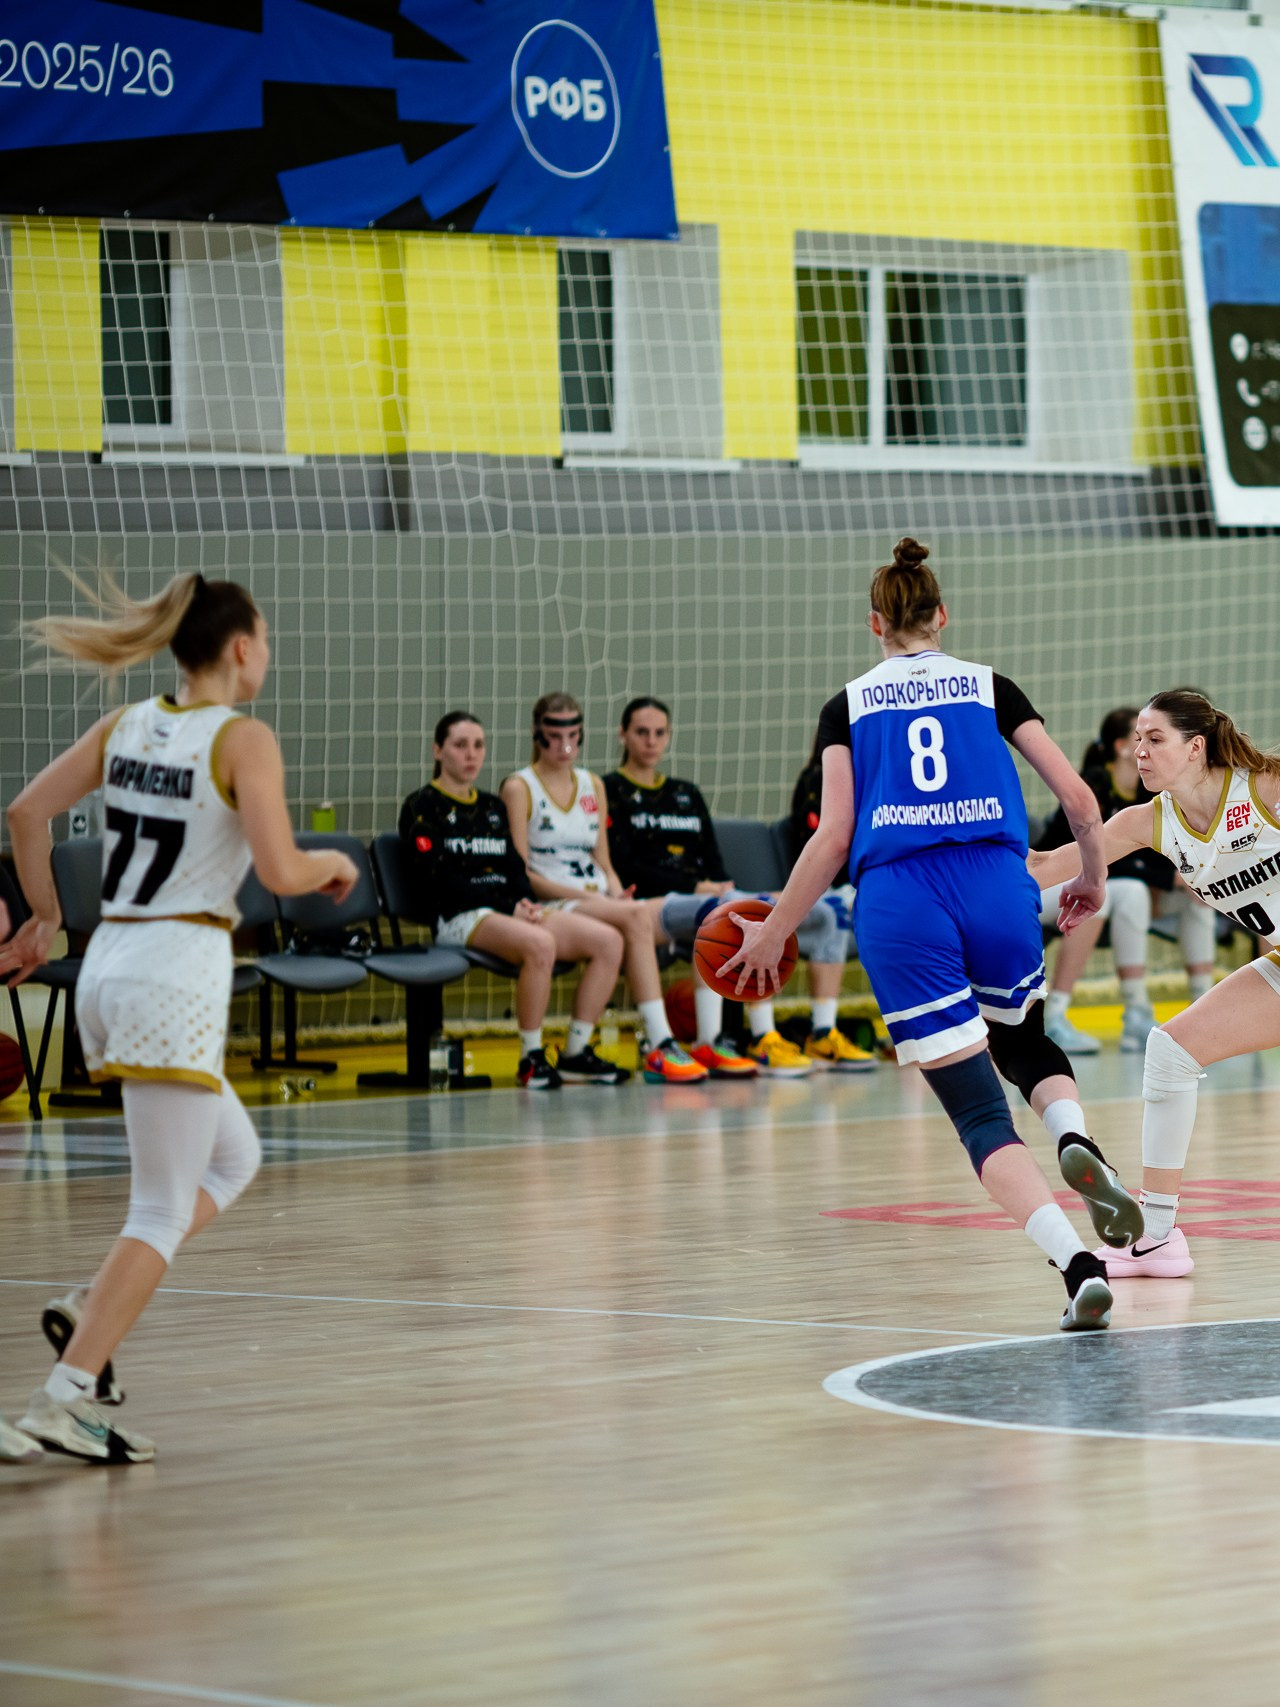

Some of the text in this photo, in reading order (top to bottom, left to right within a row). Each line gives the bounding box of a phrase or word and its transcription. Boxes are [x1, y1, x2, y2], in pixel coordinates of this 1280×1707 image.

[0, 38, 175, 97] 2025/26
[524, 75, 607, 121] РФБ
[862, 676, 980, 708] ПОДКОРЫТОВА
[907, 716, 948, 792] 8
[108, 755, 194, 800] КИРИЛЕНКО
[872, 797, 1003, 829] НОВОСИБИРСКАЯ ОБЛАСТЬ
[1226, 802, 1250, 820] FON
[1226, 813, 1250, 832] BET
[101, 805, 186, 906] 77
